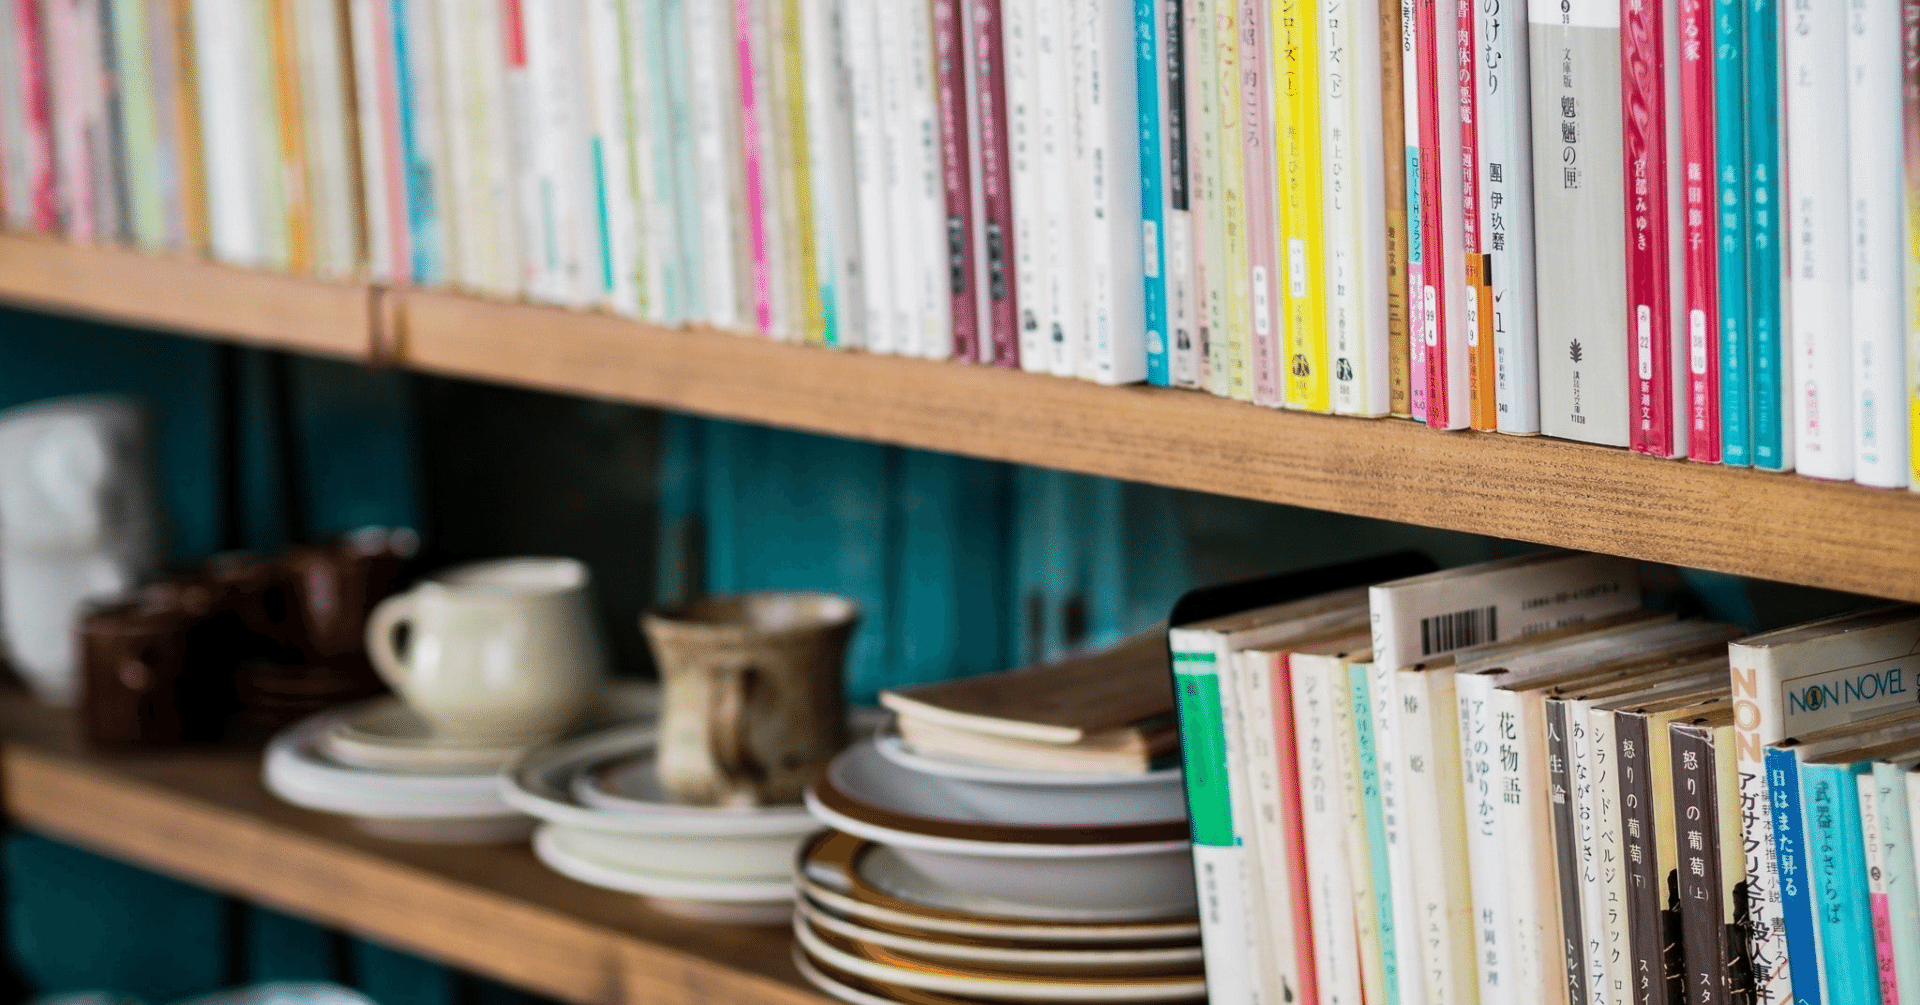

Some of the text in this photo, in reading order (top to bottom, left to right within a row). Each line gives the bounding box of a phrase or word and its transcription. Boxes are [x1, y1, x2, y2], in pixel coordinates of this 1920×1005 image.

[1242, 0, 1260, 148] 沢昭一的こころ
[1483, 0, 1502, 96] のけむり
[1561, 47, 1573, 89] 文庫版
[1332, 127, 1343, 210] 井上ひさし
[1560, 95, 1579, 189] 魍魎の匣
[1634, 158, 1648, 251] 宮部みゆき
[1687, 162, 1703, 251] 篠田節子
[1428, 330, 1433, 341] 4
[1640, 335, 1649, 349] 22
[1572, 370, 1581, 413] 講談社文庫
[1640, 380, 1651, 431] 新潮文庫
[1694, 380, 1704, 431] 新潮文庫
[1371, 613, 1390, 731] コンプレックス
[1731, 667, 1762, 764] NON
[1789, 681, 1840, 716] NON
[1845, 667, 1907, 704] NOVEL
[1403, 694, 1425, 774] 椿姫
[1471, 700, 1496, 838] アンのゆりかご
[1498, 711, 1522, 806] 花物語
[1548, 722, 1567, 806] 人生論
[1573, 721, 1596, 884] あしながおじさん
[1772, 769, 1798, 898] 日はまた昇る
[1737, 771, 1776, 1005] アガサ・クリスティ殺人事件
[1426, 902, 1446, 1005] デュマ・フィ
[1699, 972, 1712, 1003] スタ
